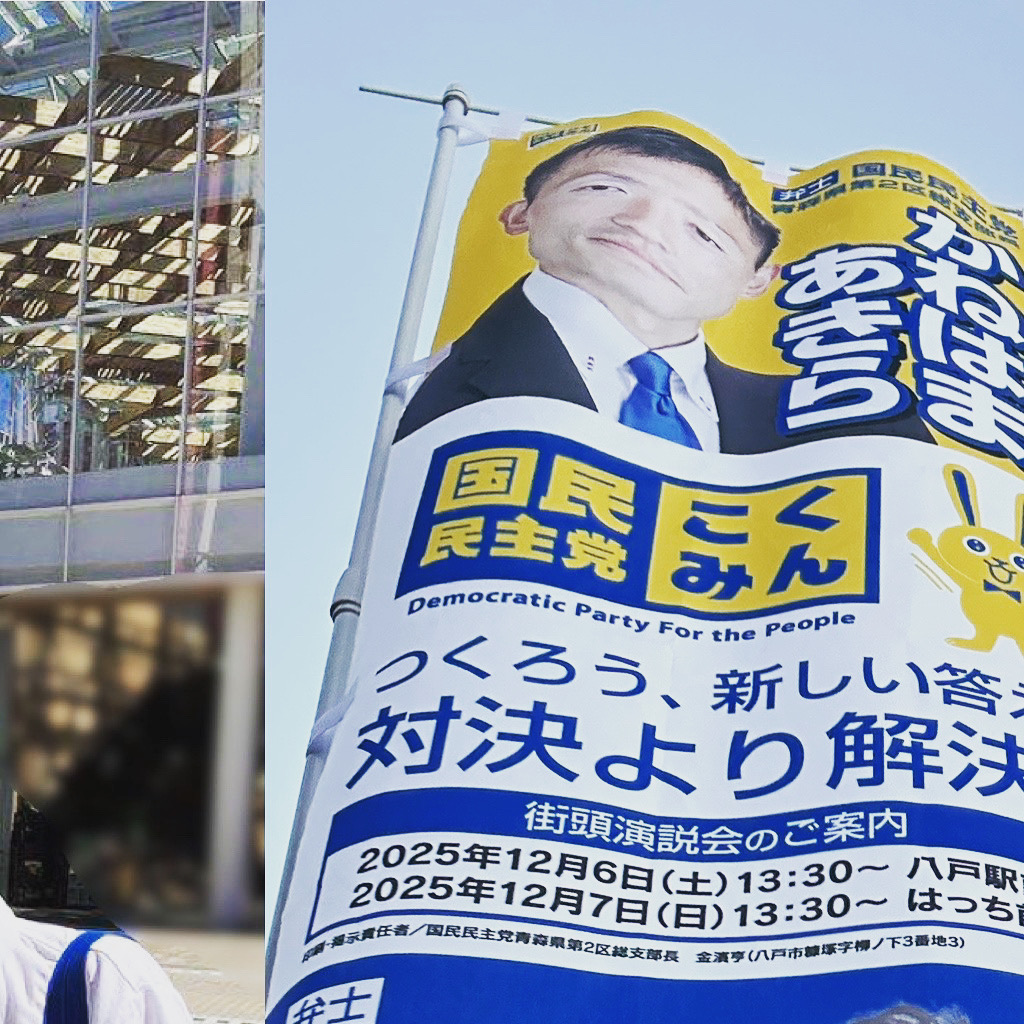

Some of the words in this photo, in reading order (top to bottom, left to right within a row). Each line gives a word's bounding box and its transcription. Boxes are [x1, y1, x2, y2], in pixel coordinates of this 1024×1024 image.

[778, 247, 903, 429] あきら
[433, 448, 636, 534] 国民
[682, 486, 839, 544] こく
[421, 515, 628, 582] 民主党
[671, 552, 848, 601] みん
[408, 590, 564, 616] Democratic
[574, 602, 650, 634] Party
[658, 620, 703, 643] For
[713, 625, 756, 643] the
[766, 610, 856, 639] People
[346, 695, 1024, 800] 対決より解決
[525, 801, 909, 855] 街頭演説会のご案内
[907, 856, 1024, 895] 八戸駅
[907, 887, 1024, 929] はっち
